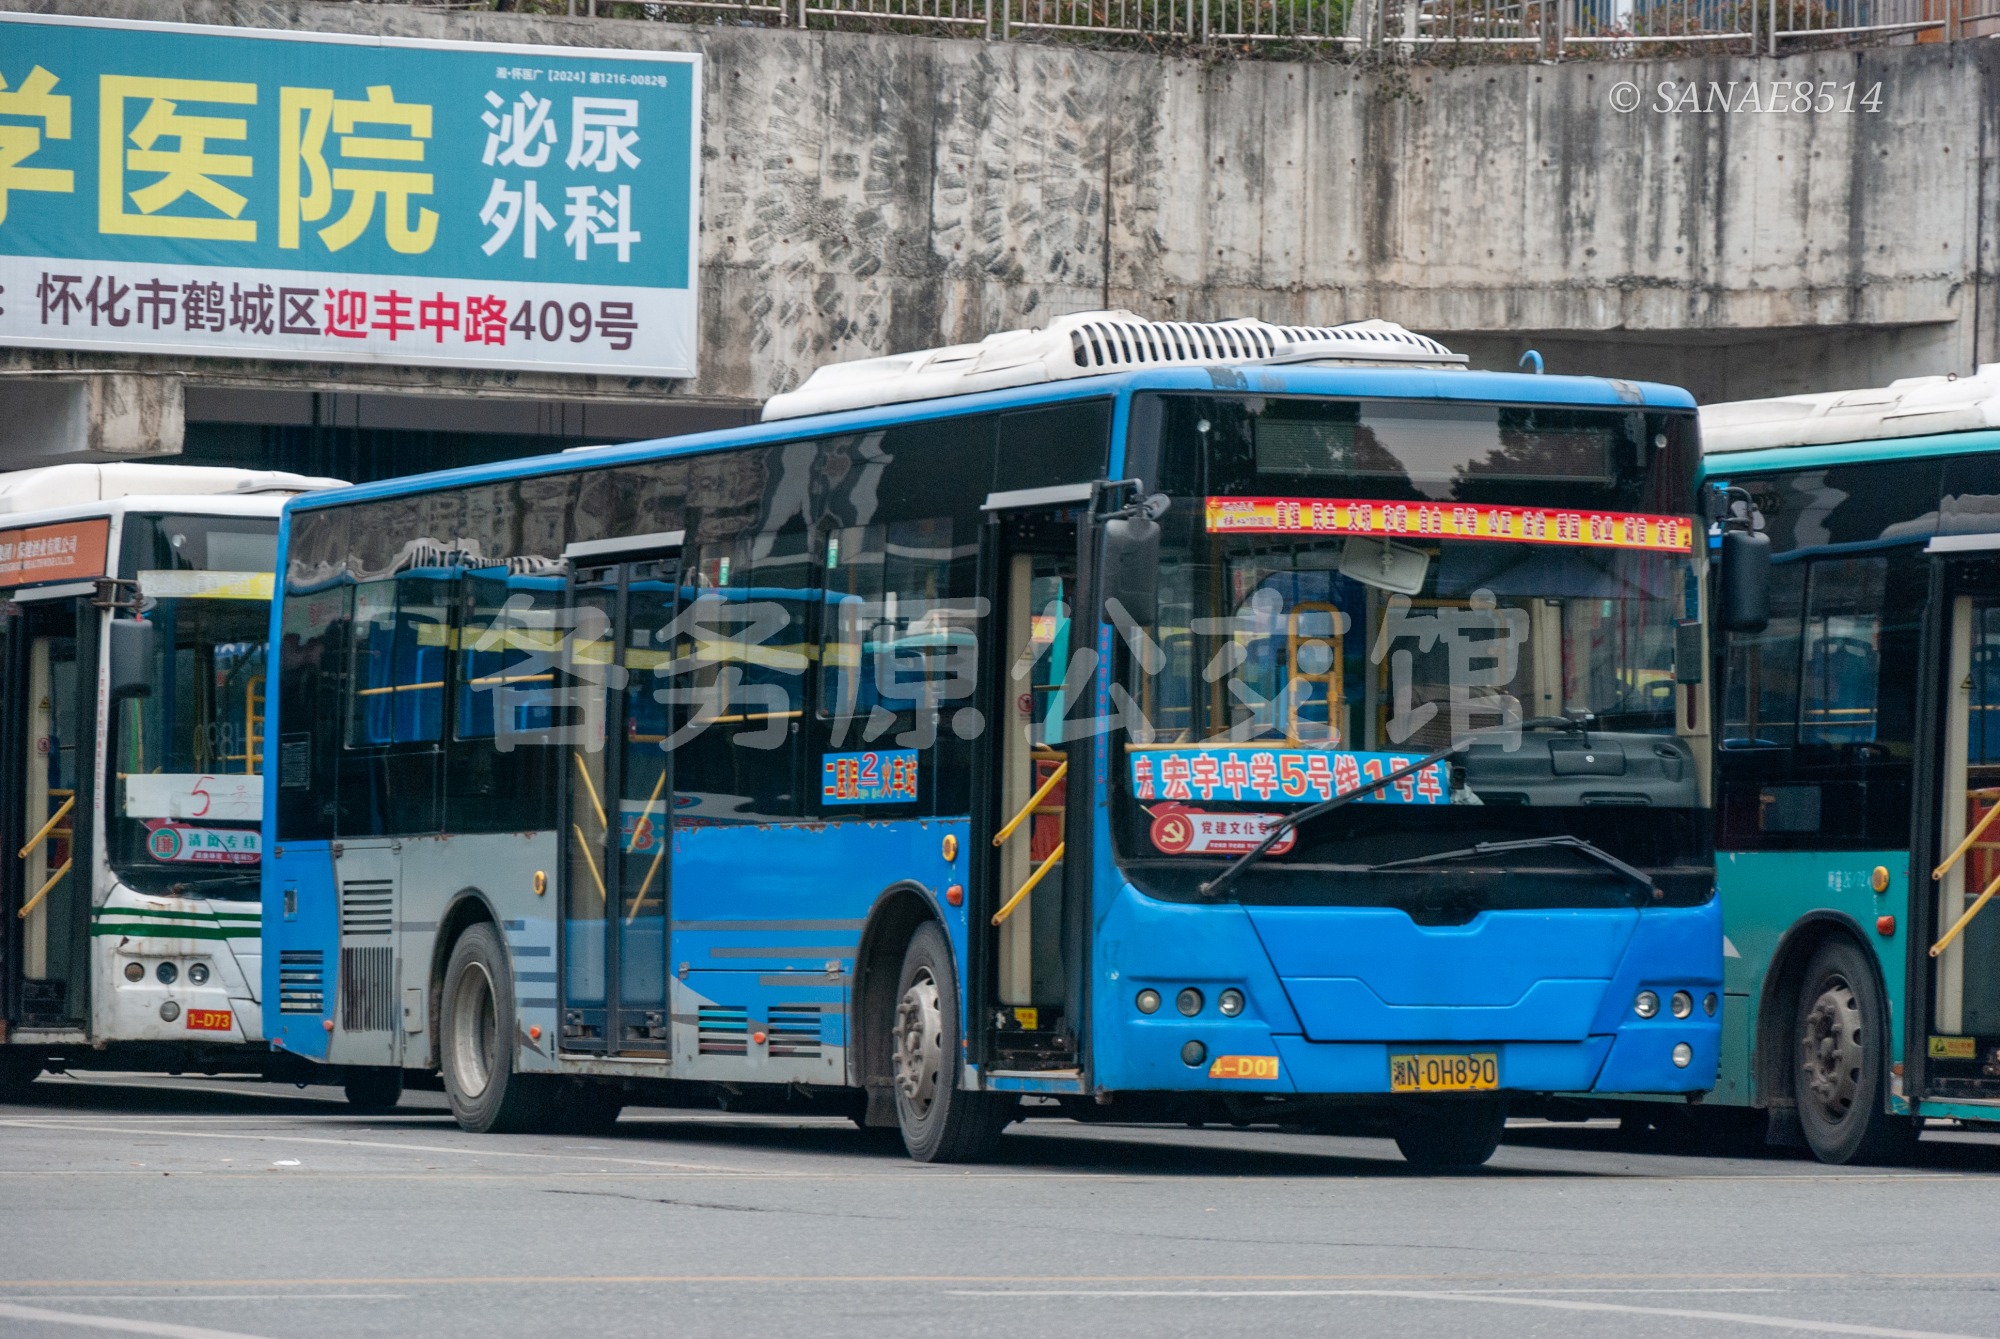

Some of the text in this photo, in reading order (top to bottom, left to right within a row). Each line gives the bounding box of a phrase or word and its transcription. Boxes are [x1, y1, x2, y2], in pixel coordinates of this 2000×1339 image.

[479, 89, 641, 173] 泌尿
[479, 179, 641, 263] 外科
[1201, 820, 1281, 835] 党建文化专
[188, 1013, 230, 1027] 1-D73
